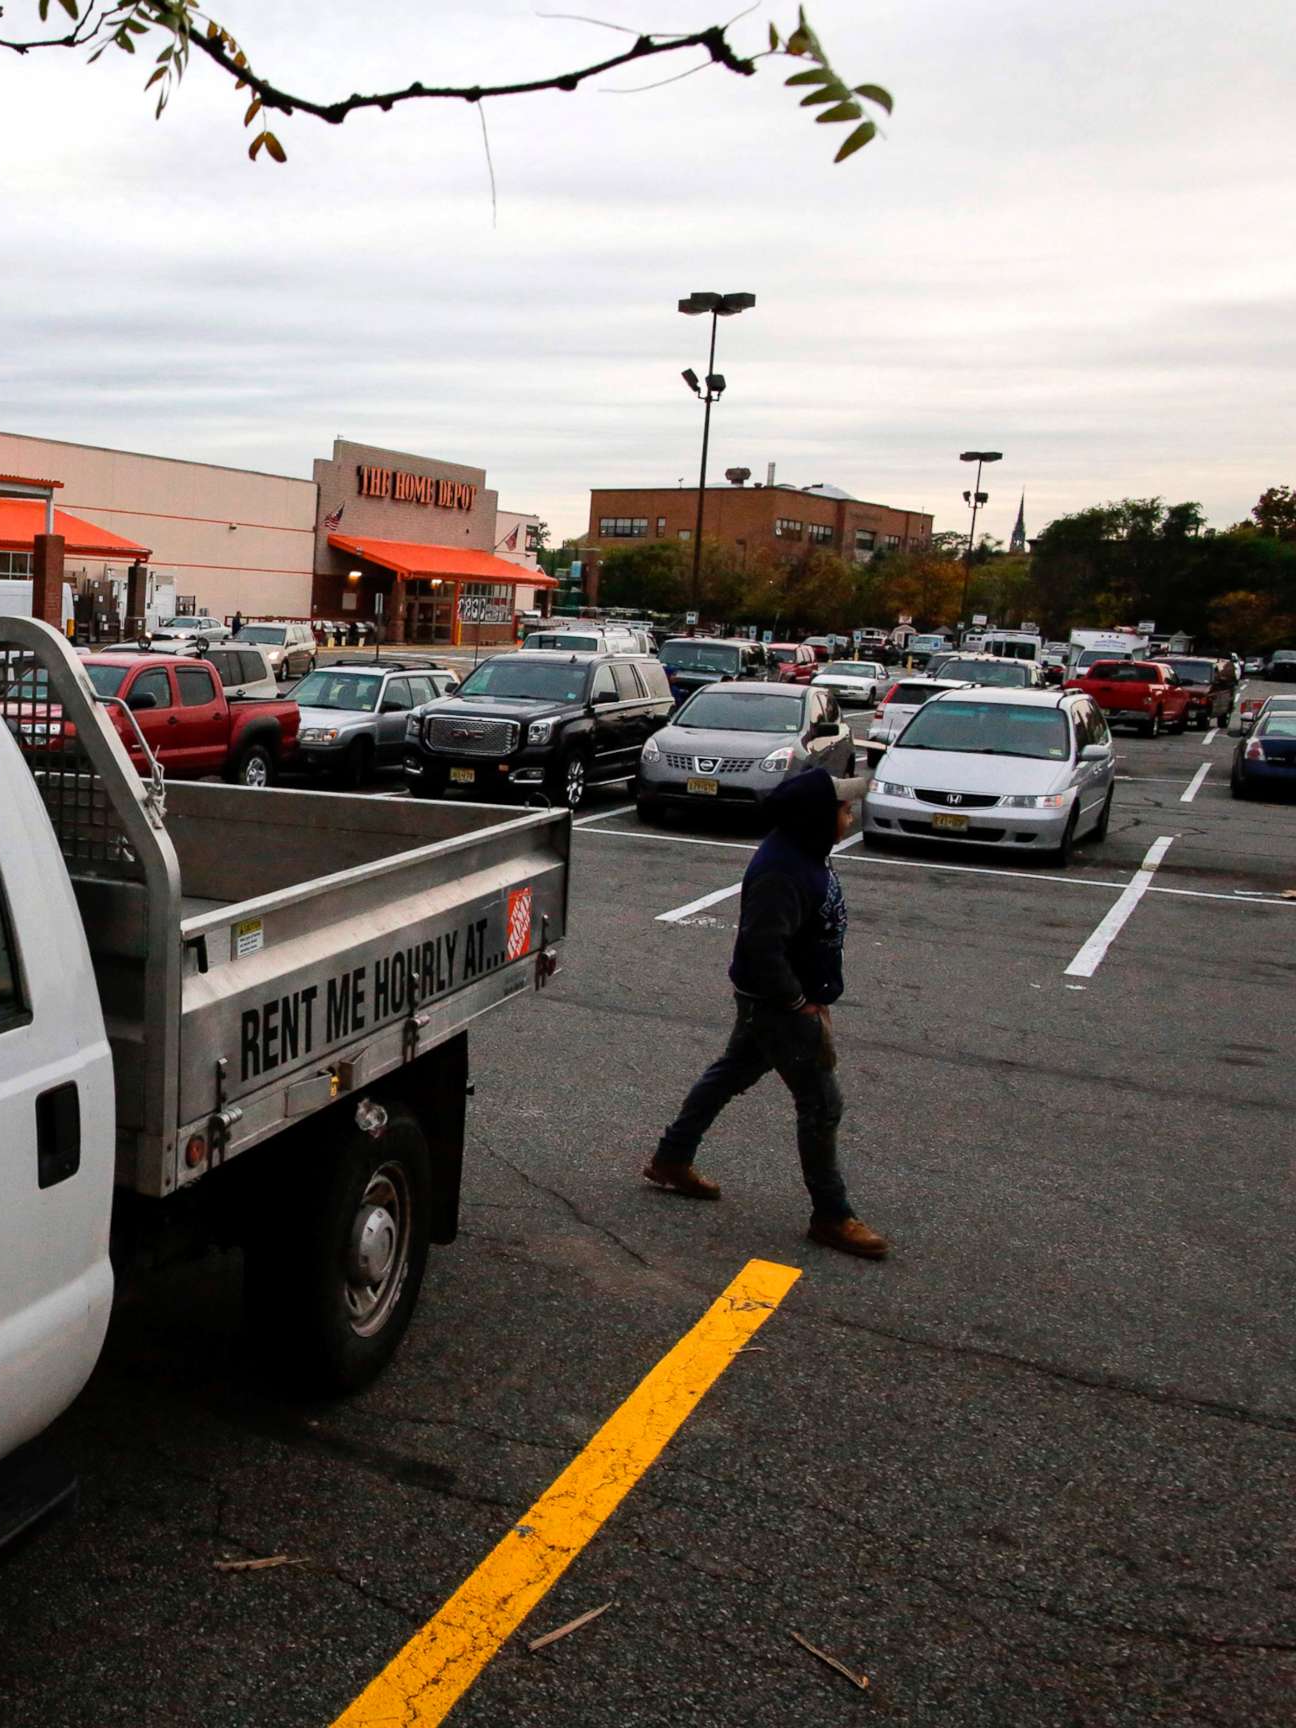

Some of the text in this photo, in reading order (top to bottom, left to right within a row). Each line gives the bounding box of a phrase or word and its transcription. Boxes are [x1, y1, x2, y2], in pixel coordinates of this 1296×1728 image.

[357, 465, 477, 511] THE HOME DEPOT
[241, 985, 317, 1082] RENT
[326, 966, 365, 1043] ME
[374, 930, 458, 1022] HOURLY
